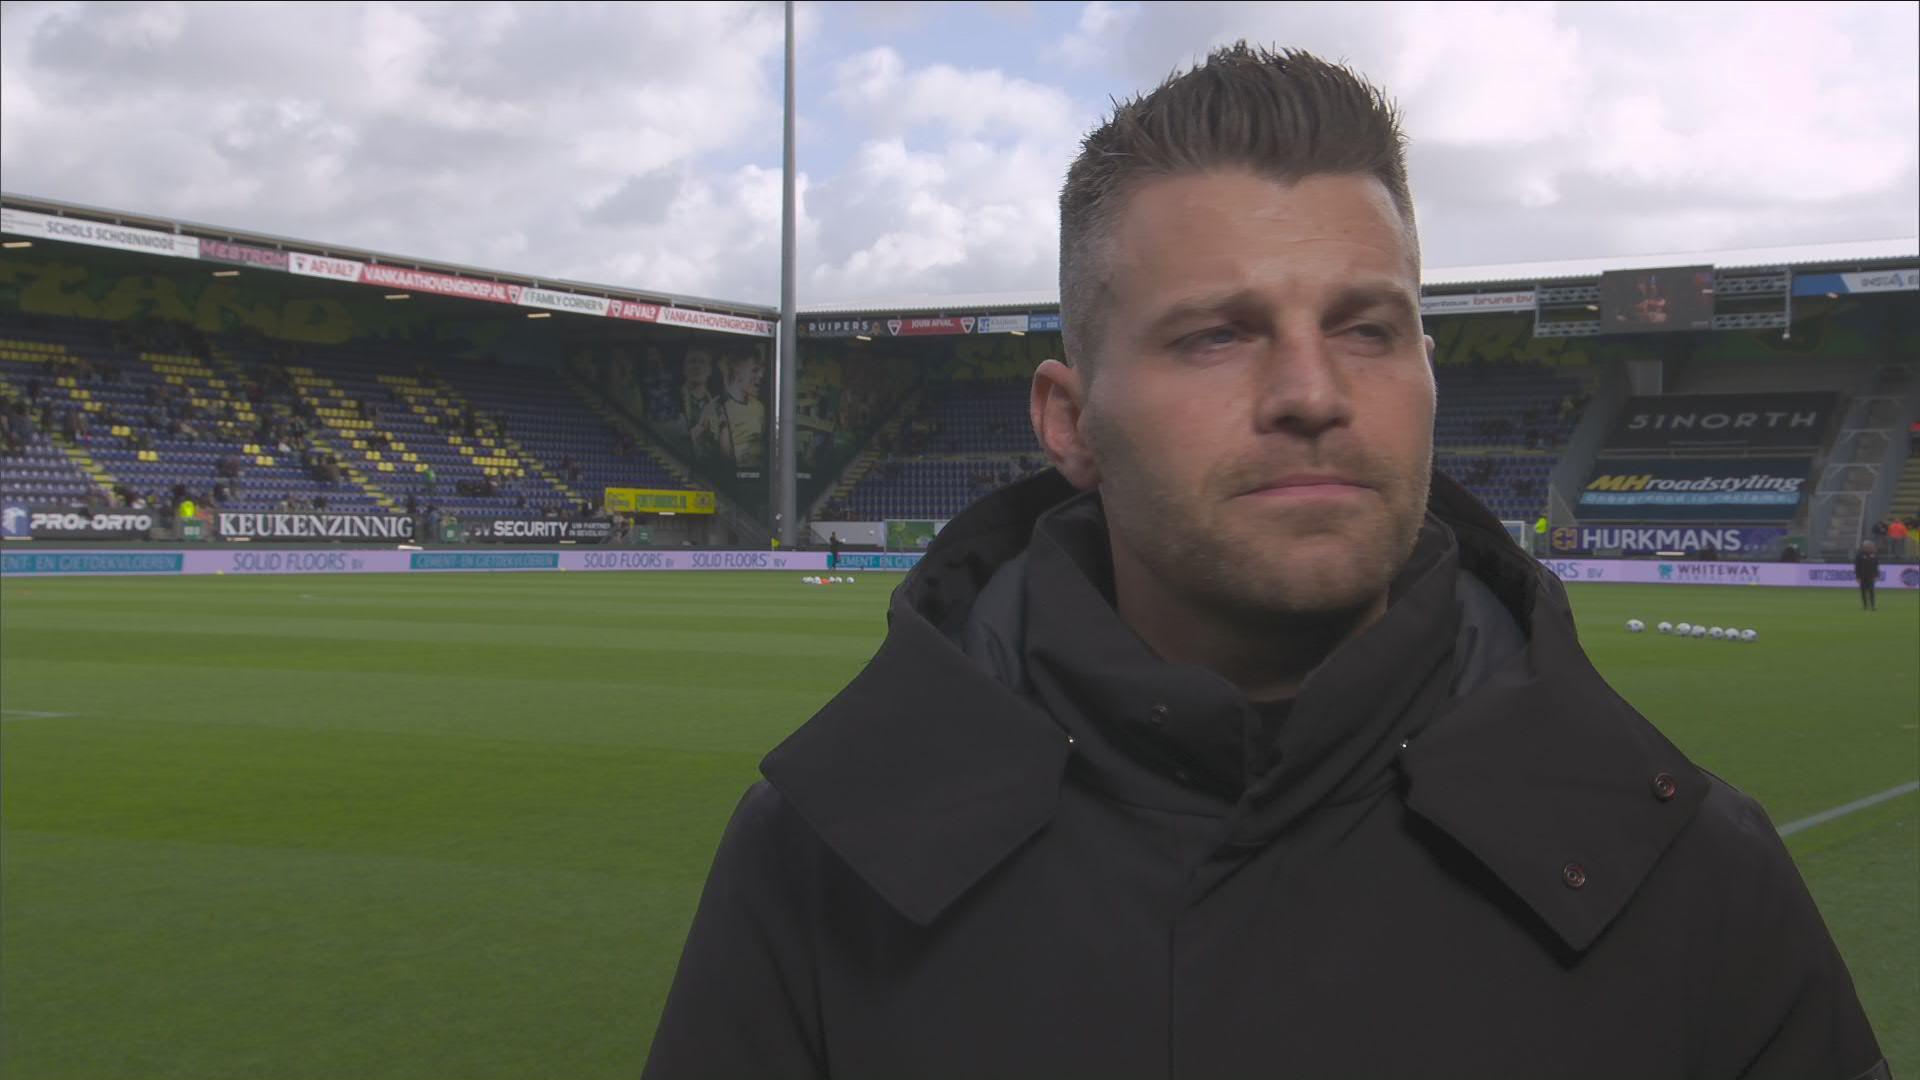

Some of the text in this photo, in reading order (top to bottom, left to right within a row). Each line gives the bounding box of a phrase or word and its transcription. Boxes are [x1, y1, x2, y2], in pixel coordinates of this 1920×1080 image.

[219, 513, 413, 538] KEUKENZINNIG
[493, 520, 568, 537] SECURITY
[1582, 528, 1741, 550] HURKMANS
[232, 553, 282, 570] SOLID
[286, 553, 347, 570] FLOORS
[584, 553, 617, 568] SOLID
[620, 553, 662, 568] FLOORS
[692, 553, 722, 568] SOLID
[724, 553, 768, 568] FLOORS
[1677, 563, 1760, 576] WHITEWAY
